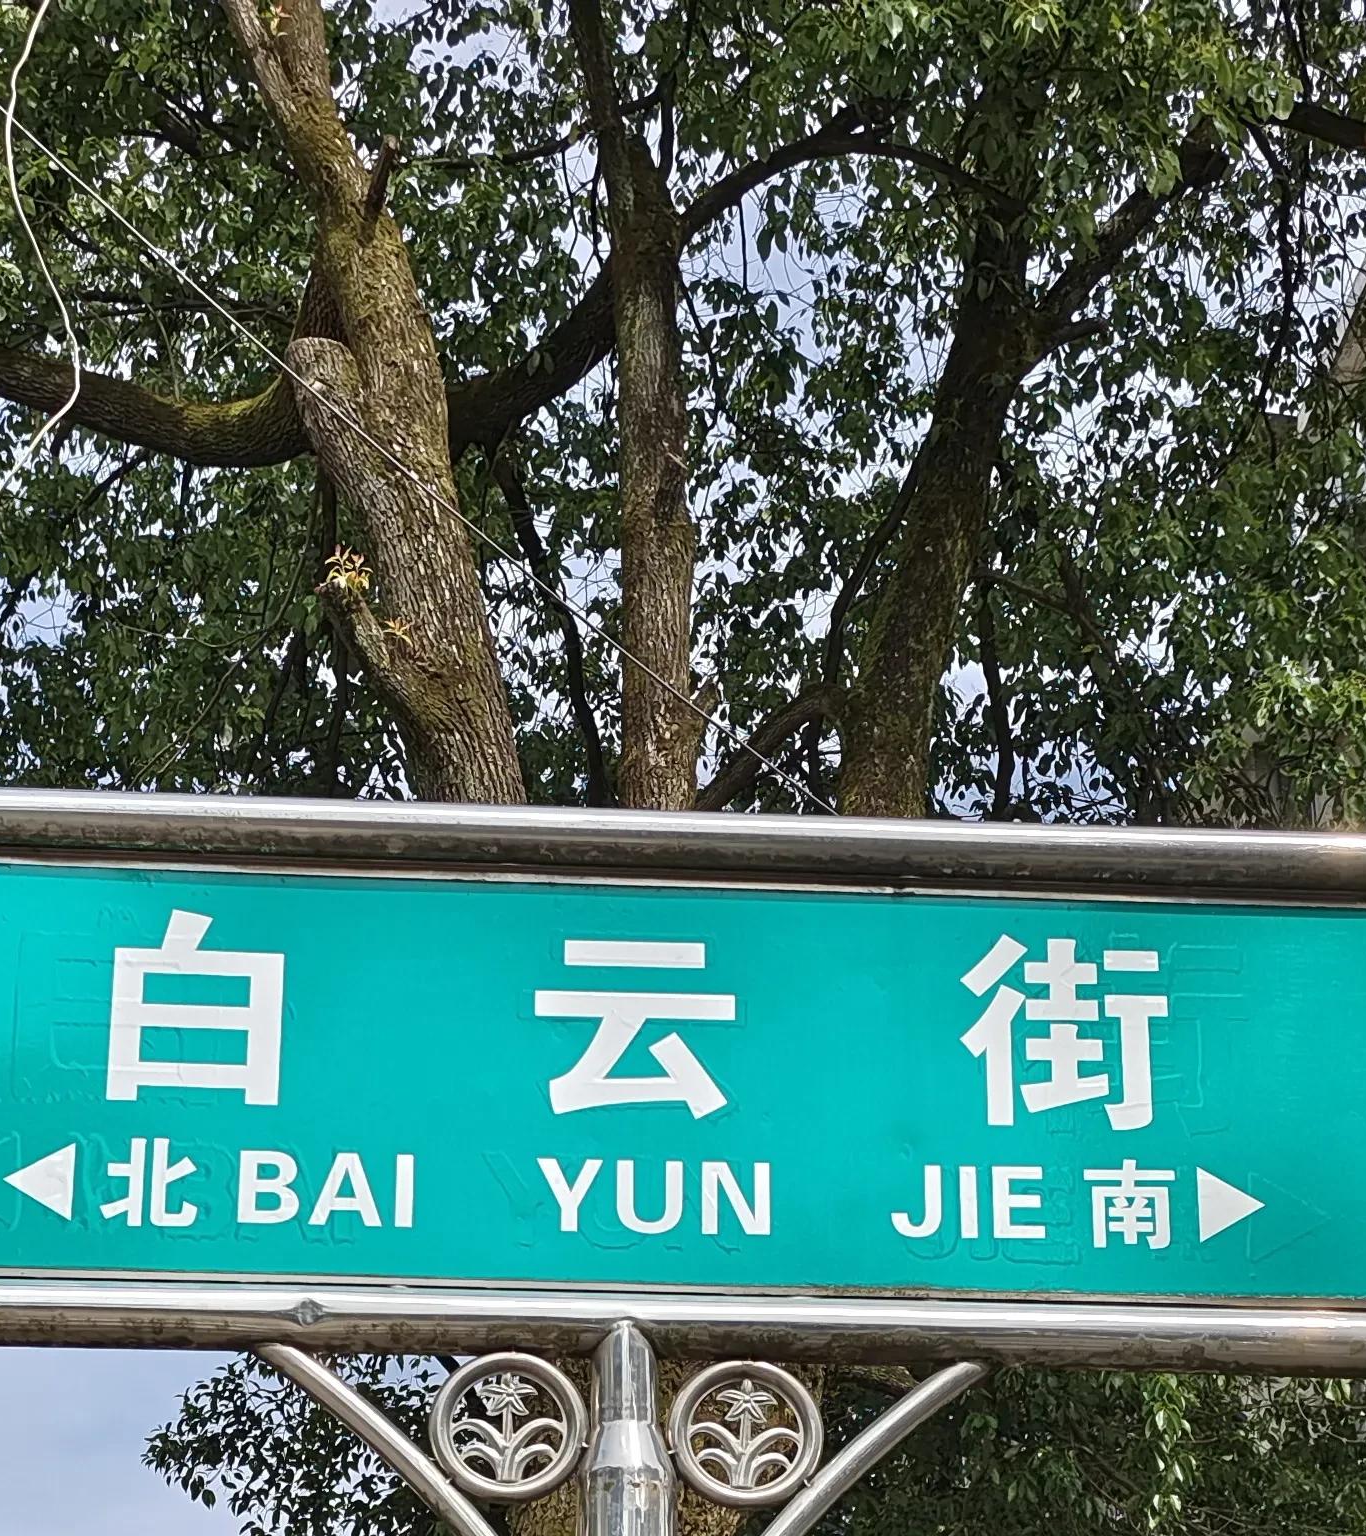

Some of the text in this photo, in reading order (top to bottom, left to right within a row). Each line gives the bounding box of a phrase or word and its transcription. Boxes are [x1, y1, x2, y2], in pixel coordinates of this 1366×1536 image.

[106, 908, 1169, 1132] 白云街
[99, 1137, 1176, 1250] 北 BAI YUN JIE 南
